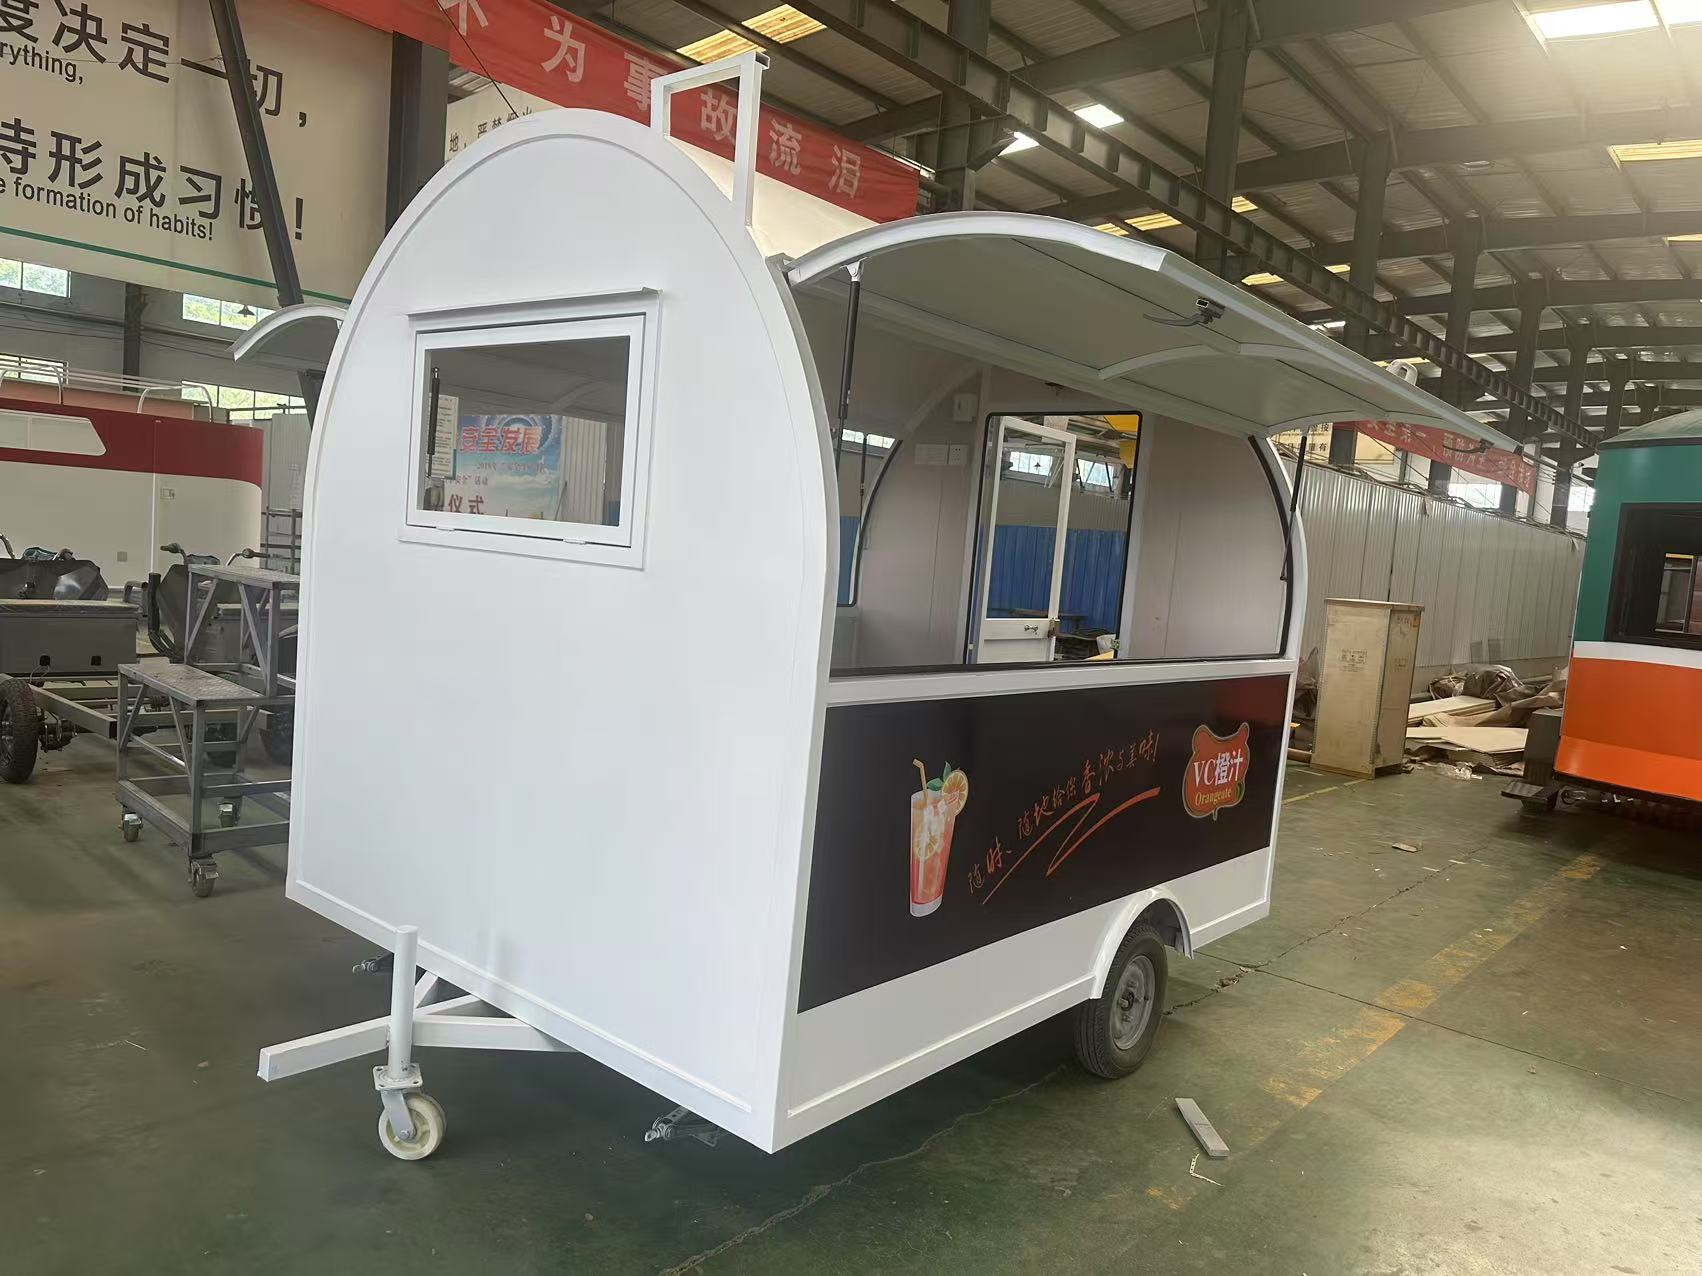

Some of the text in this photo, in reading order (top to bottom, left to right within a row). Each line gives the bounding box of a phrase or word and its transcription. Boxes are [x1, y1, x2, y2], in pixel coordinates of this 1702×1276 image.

[14, 177, 116, 220] formation
[124, 205, 143, 225] of
[150, 206, 213, 241] habits!
[460, 425, 542, 456] 安全发展
[1193, 749, 1243, 787] VC橙汁
